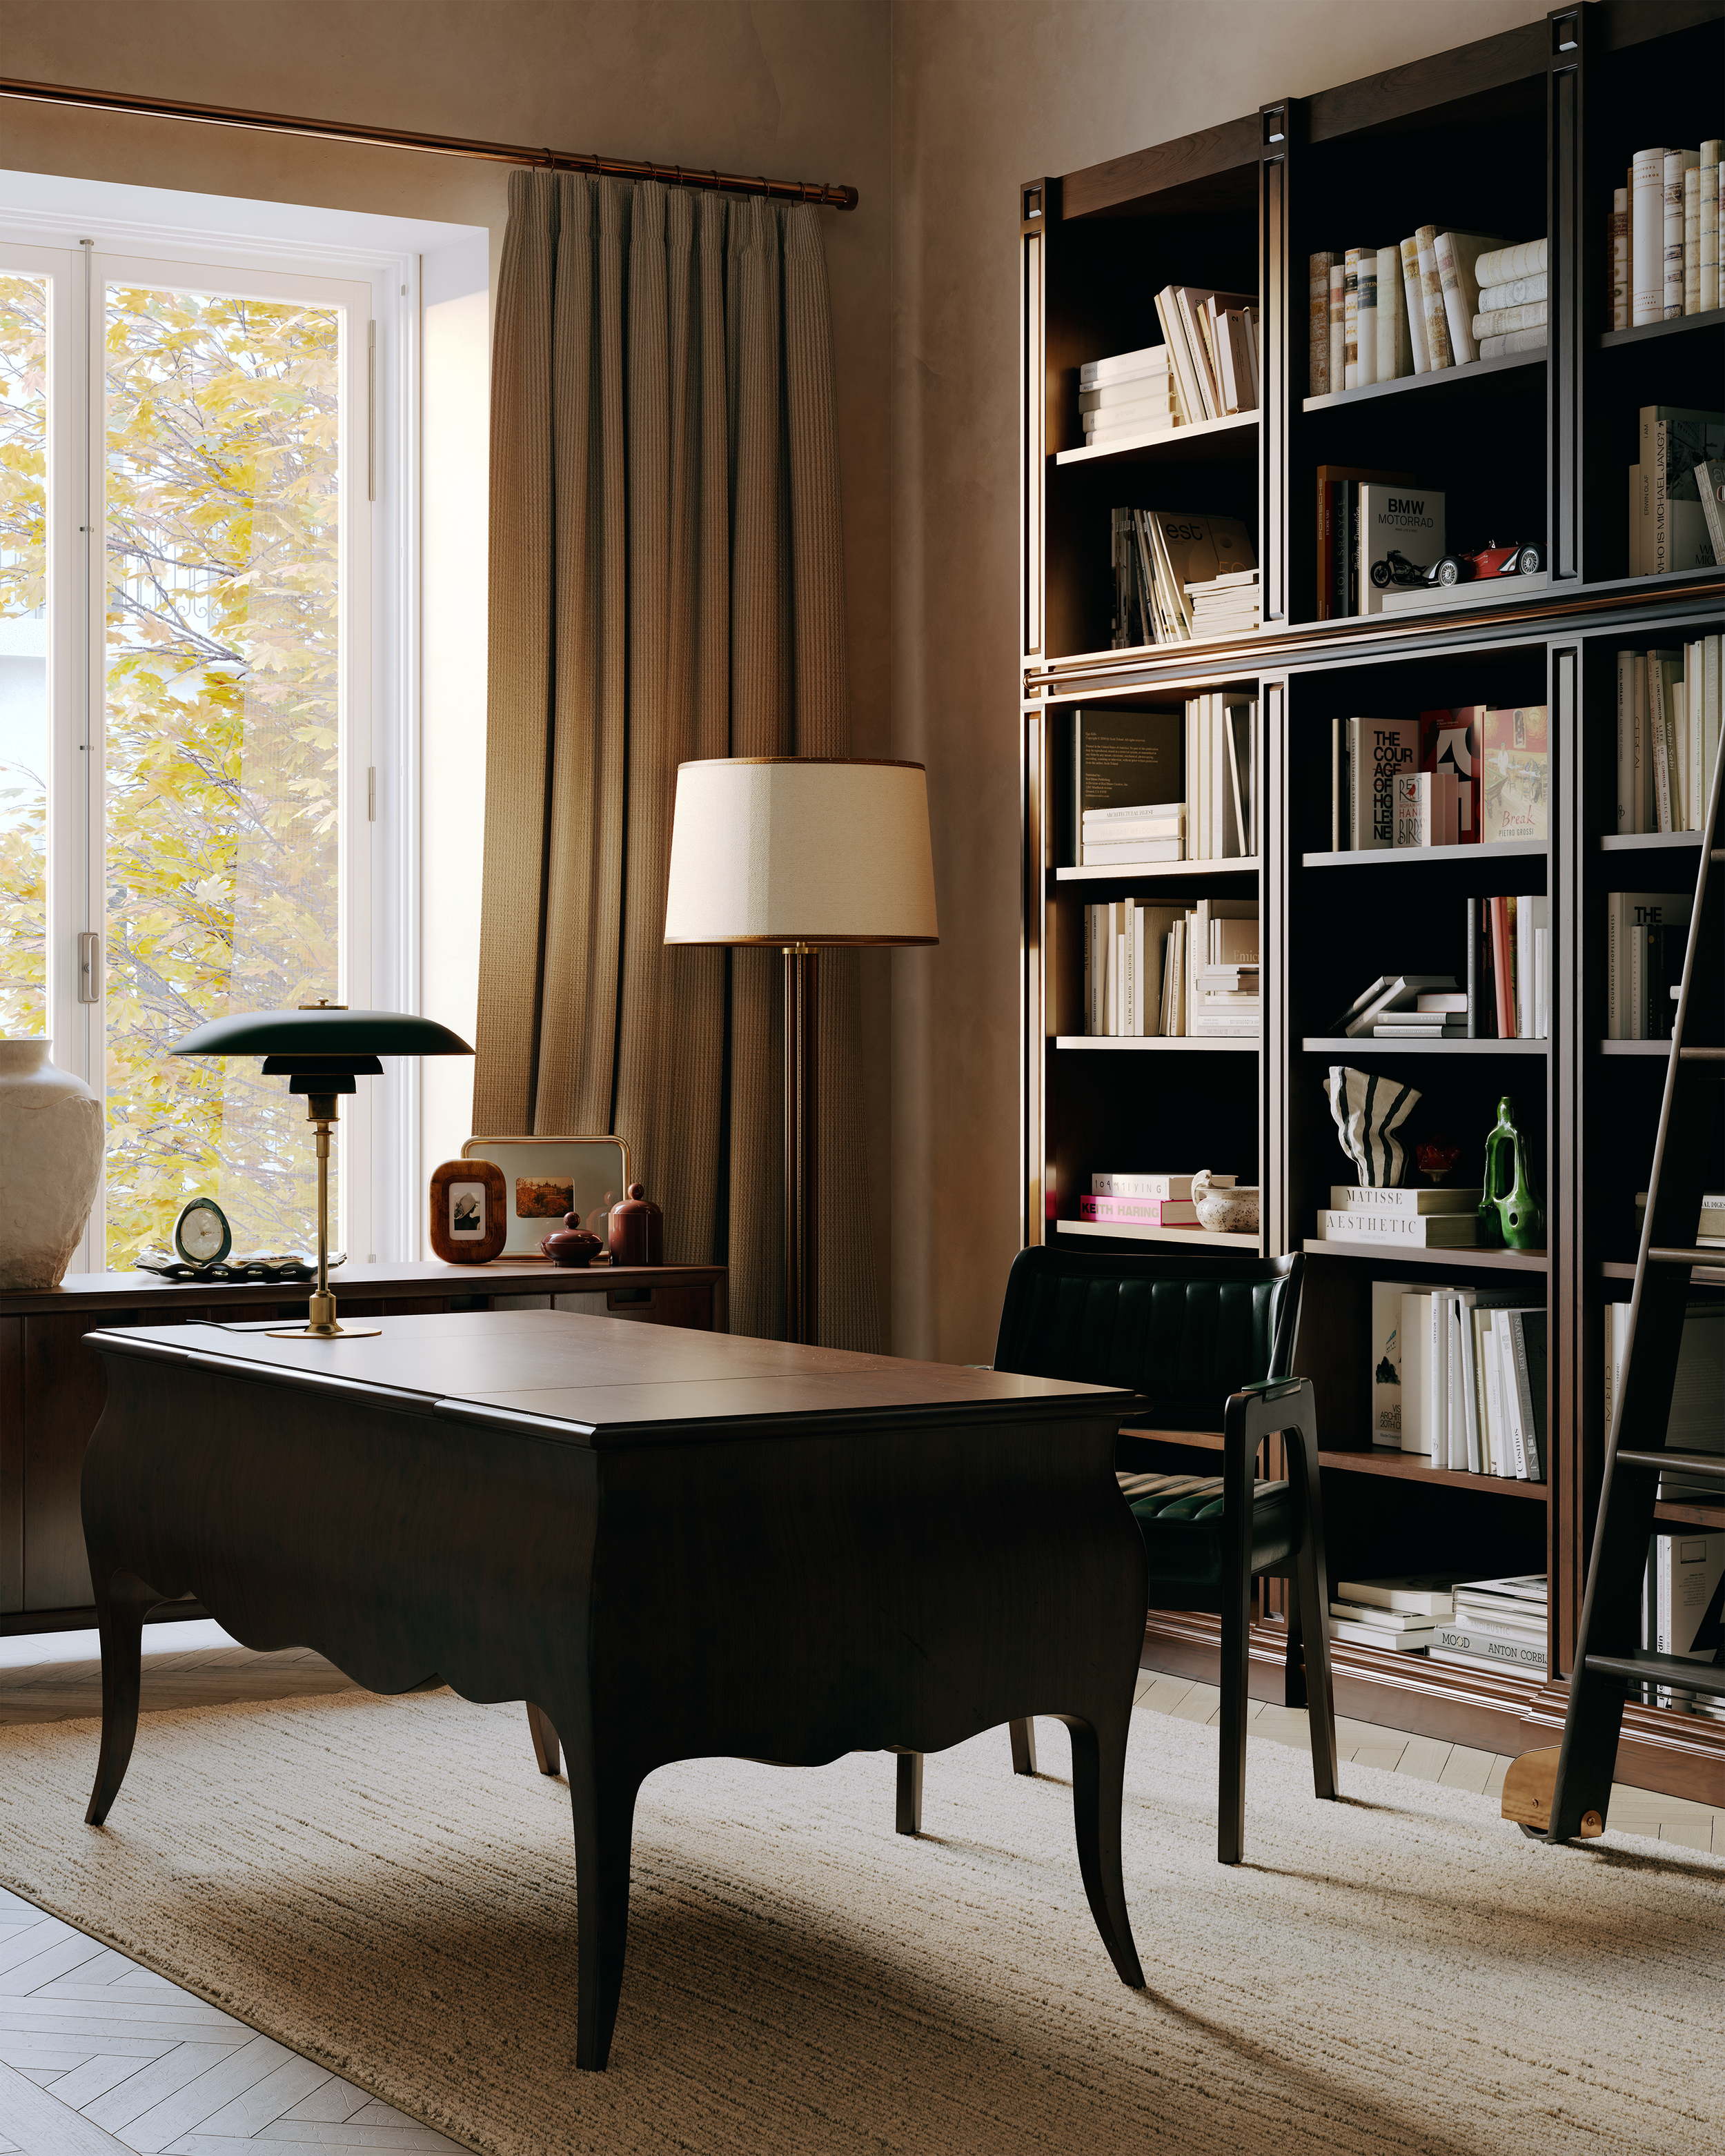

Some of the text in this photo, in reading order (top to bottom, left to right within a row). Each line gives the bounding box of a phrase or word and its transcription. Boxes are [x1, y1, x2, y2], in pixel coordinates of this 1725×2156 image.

[1644, 424, 1649, 435] AM
[1388, 497, 1425, 515] BMW
[1378, 513, 1434, 528] MOTORRAD
[1165, 522, 1203, 541] est
[1657, 531, 1665, 543] IS
[1373, 730, 1400, 747] THE
[1666, 722, 1675, 770] Wabi-Sabi
[1373, 746, 1413, 763] COUR
[1660, 747, 1665, 755] OF
[1677, 735, 1685, 778] Wabi-Sabi
[1373, 762, 1402, 778] AGE
[1373, 778, 1393, 793] OF
[1501, 804, 1535, 828] Break
[1130, 827, 1159, 835] WELCOME
[1499, 828, 1534, 837] PIETRO GROSSI
[1634, 906, 1662, 923] THE
[1346, 1189, 1403, 1205] MATISSE
[1081, 1203, 1160, 1218] KEITH HARING
[1326, 1215, 1417, 1234] AESTHETIC
[1514, 1318, 1525, 1370] NAERVAER
[1380, 1419, 1395, 1429] 20TH
[1514, 1428, 1523, 1472] Cosmos
[1461, 1618, 1510, 1636] SCANDIRUSTIC
[1441, 1632, 1471, 1649] MOOD
[1488, 1643, 1518, 1659] ANTON
